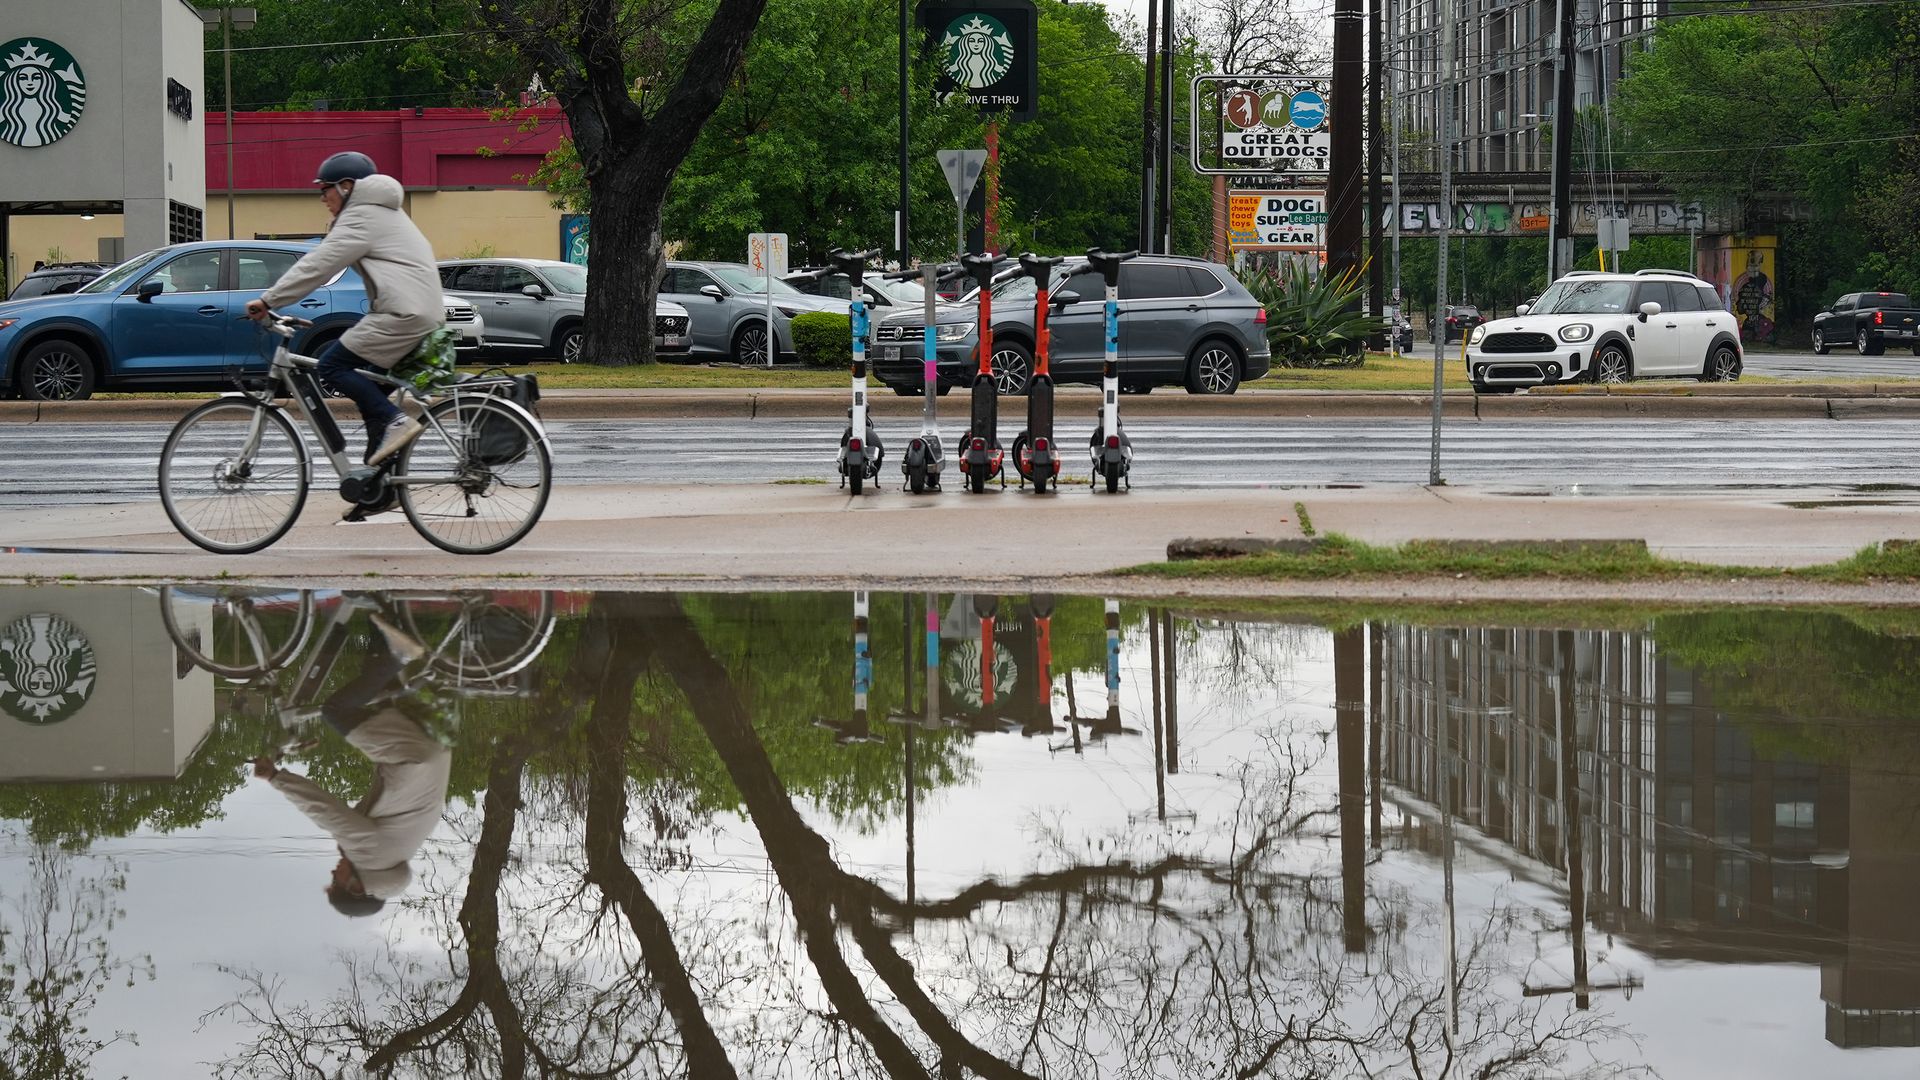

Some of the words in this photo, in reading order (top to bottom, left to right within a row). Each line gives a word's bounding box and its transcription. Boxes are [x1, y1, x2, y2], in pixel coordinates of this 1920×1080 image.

[963, 95, 988, 104] RIVE
[991, 95, 1020, 104] THRU
[1241, 134, 1313, 144] GREAT
[1225, 146, 1328, 157] OUTDOGS
[1231, 197, 1259, 205] treats
[1267, 199, 1314, 212] DOG
[1289, 214, 1303, 223] Lee
[1231, 220, 1251, 228] toys
[1267, 233, 1314, 243] GEAR
